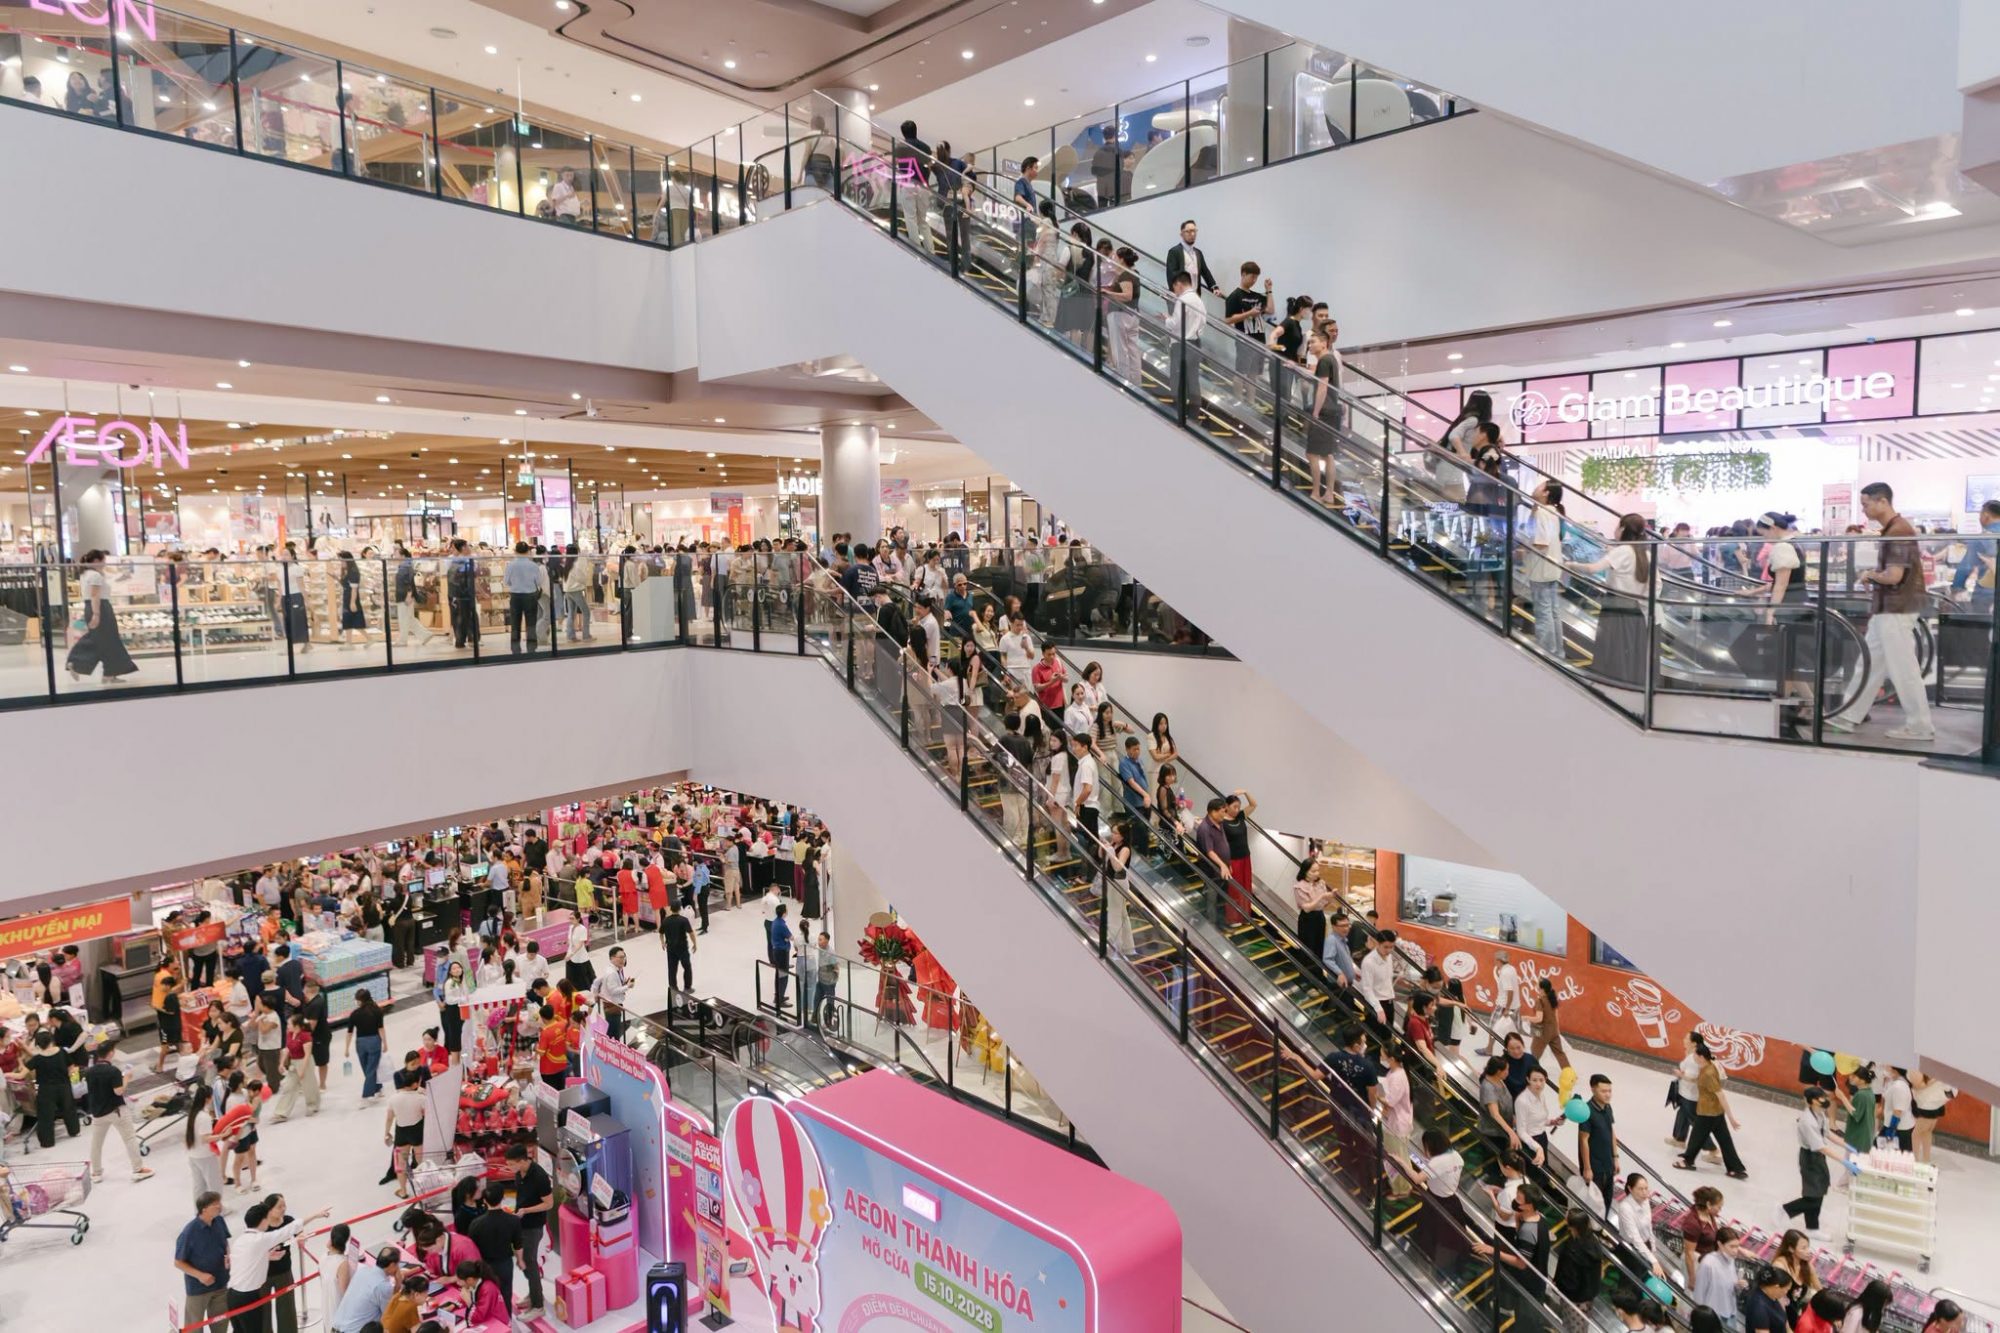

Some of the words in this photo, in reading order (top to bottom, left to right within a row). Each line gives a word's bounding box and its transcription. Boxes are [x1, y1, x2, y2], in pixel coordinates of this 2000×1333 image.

[1557, 391, 1655, 423] Glam
[1665, 370, 1895, 416] Beautique
[1521, 975, 1584, 1008] bak
[694, 1147, 721, 1168] AEON
[695, 1139, 721, 1155] FOLLOW
[843, 1188, 897, 1239] AEON
[901, 1219, 978, 1288] THANH
[983, 1266, 1035, 1322] HÓA
[862, 1234, 881, 1259] MỞ
[883, 1247, 911, 1279] CỬA
